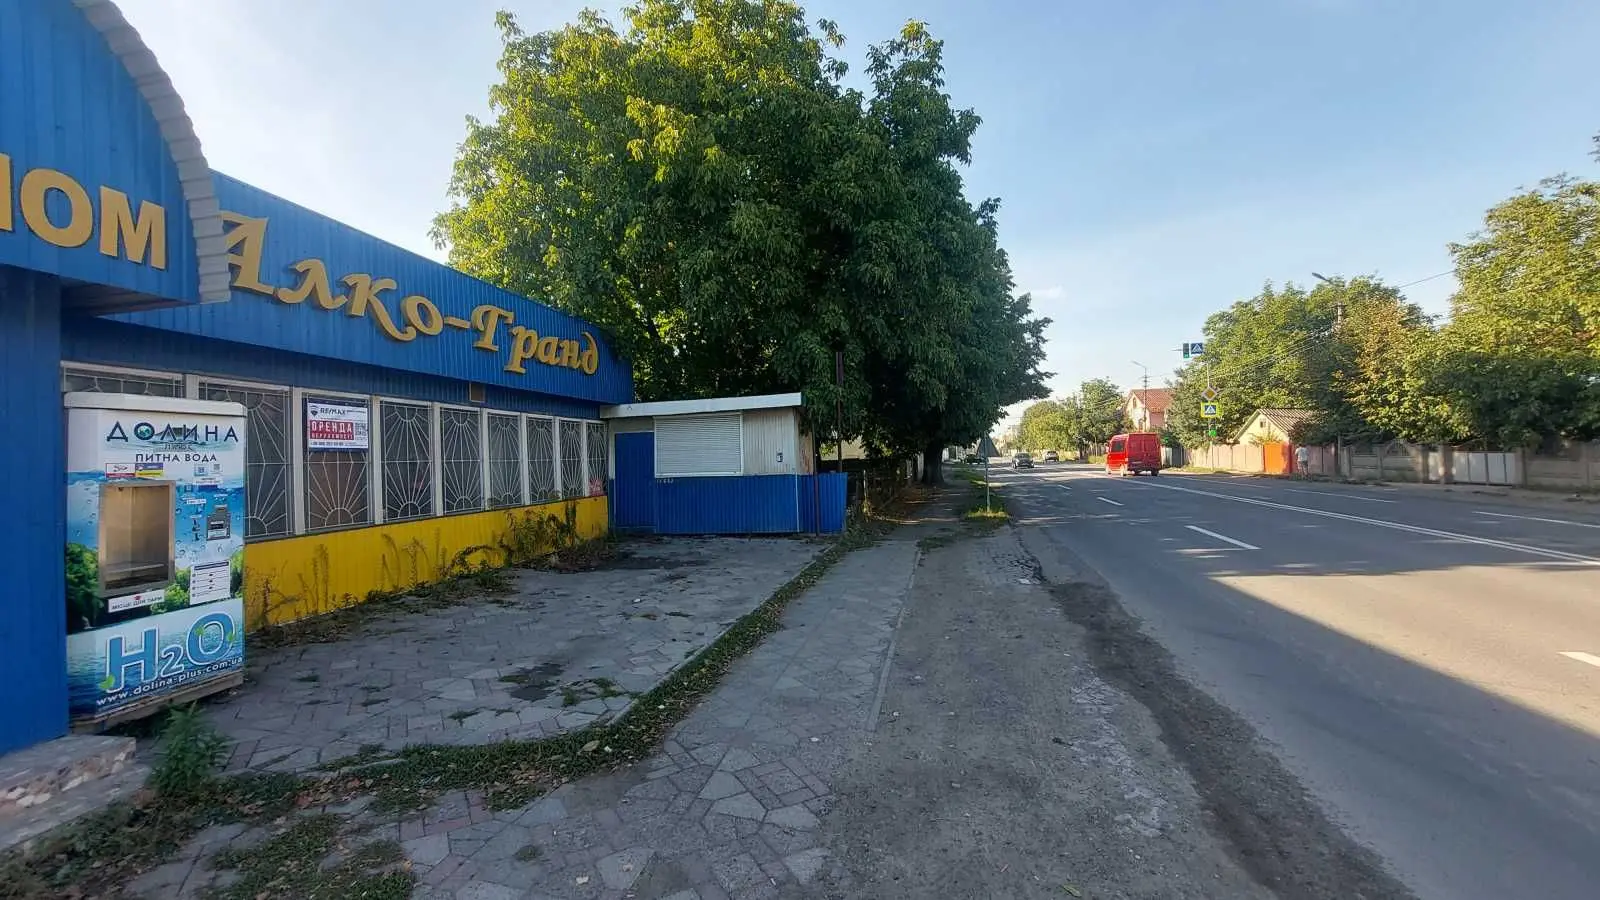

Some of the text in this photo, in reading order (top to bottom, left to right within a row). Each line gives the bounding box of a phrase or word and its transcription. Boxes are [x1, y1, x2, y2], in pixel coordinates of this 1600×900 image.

[320, 407, 346, 415] RE/MAX
[106, 420, 239, 443] ДОЛИНА
[311, 421, 353, 433] ОРЕНДА
[135, 453, 217, 462] ПИТНА ВОДА
[106, 612, 235, 694] H2O
[96, 656, 243, 706] www.dolina-plus.com.ua
